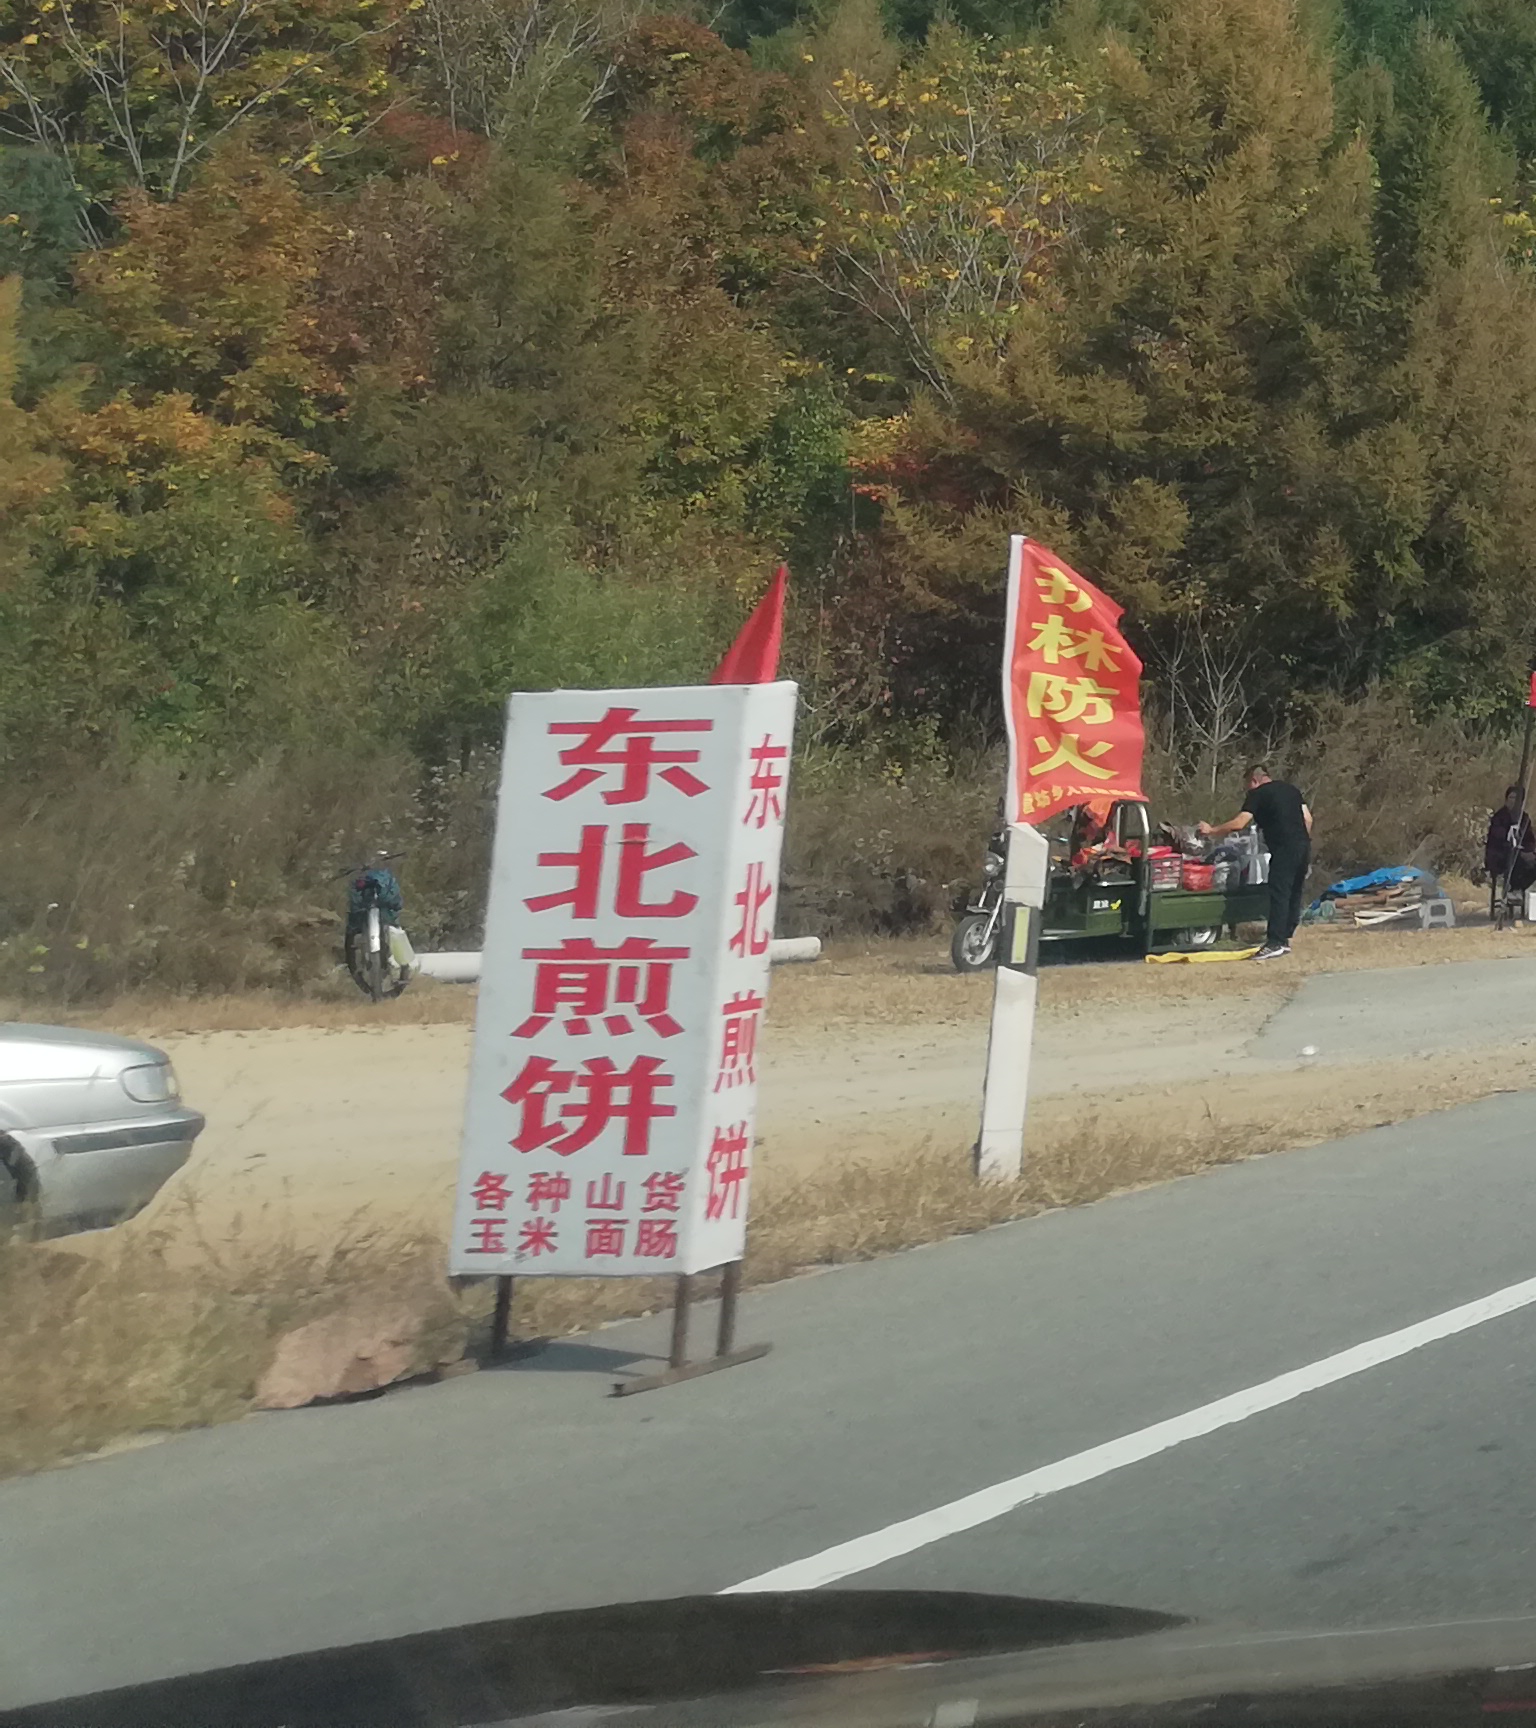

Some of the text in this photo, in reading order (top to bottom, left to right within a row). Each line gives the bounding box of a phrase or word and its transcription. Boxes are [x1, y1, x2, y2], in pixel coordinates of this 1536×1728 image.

[501, 707, 713, 1156] 东北煎饼
[704, 733, 787, 1221] 东北煎饼
[464, 1216, 677, 1259] 玉米面肠
[470, 1170, 688, 1214] 各种山货
